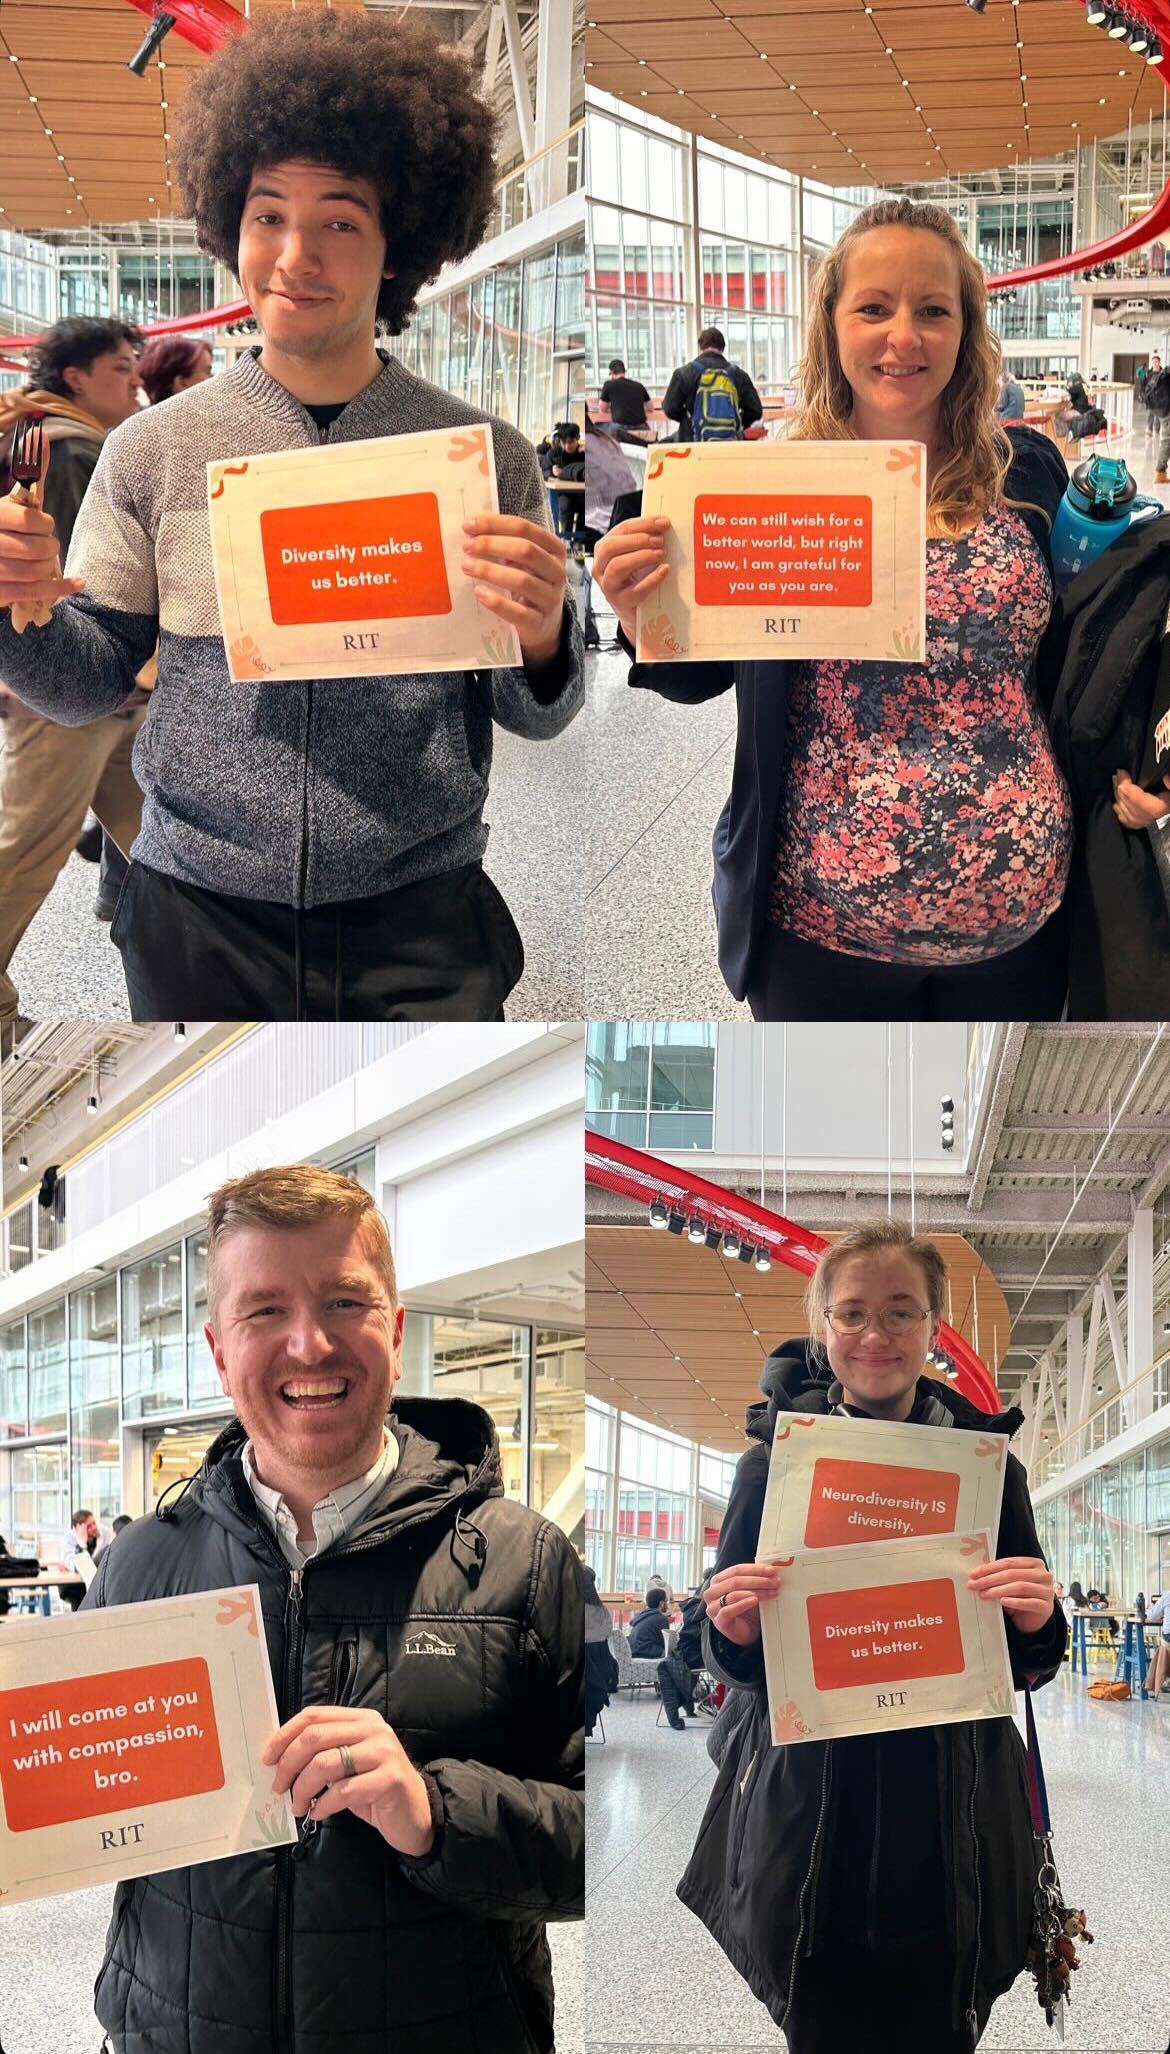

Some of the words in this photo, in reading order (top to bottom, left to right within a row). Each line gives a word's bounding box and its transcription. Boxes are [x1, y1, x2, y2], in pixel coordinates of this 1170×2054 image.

[702, 513, 726, 526] We
[730, 516, 757, 526] can
[761, 512, 787, 526] still
[791, 512, 825, 526] wish
[828, 513, 850, 526] for
[853, 518, 863, 526] a
[281, 544, 356, 564] Diversity
[361, 538, 422, 557] makes
[703, 535, 747, 548] better
[751, 535, 797, 550] world,
[801, 535, 825, 548] but
[829, 535, 864, 553] right
[705, 558, 740, 573] now,
[742, 558, 748, 570] I
[751, 561, 774, 570] am
[778, 557, 836, 573] grateful
[840, 557, 861, 570] for
[311, 577, 332, 590] us
[335, 570, 398, 588] better.
[728, 582, 755, 595] you
[758, 582, 776, 592] as
[779, 582, 806, 595] you
[809, 582, 838, 592] are.
[765, 618, 801, 633] RIT
[343, 634, 380, 650] RIT
[821, 1486, 928, 1514] Neurodiversity
[931, 1500, 947, 1514] IS
[847, 1511, 914, 1533] diversity.
[825, 1619, 890, 1638] Diversity
[893, 1612, 944, 1630] makes
[850, 1647, 870, 1659] us
[872, 1640, 924, 1656] better.
[876, 1691, 907, 1708] RIT
[9, 1719, 17, 1738] I
[22, 1710, 63, 1735] will
[68, 1705, 128, 1726] come
[134, 1695, 156, 1716] at
[160, 1691, 198, 1714] you
[13, 1744, 63, 1770] with
[68, 1723, 204, 1760] compassion,
[93, 1768, 139, 1790] bro.
[99, 1823, 145, 1850] RIT
